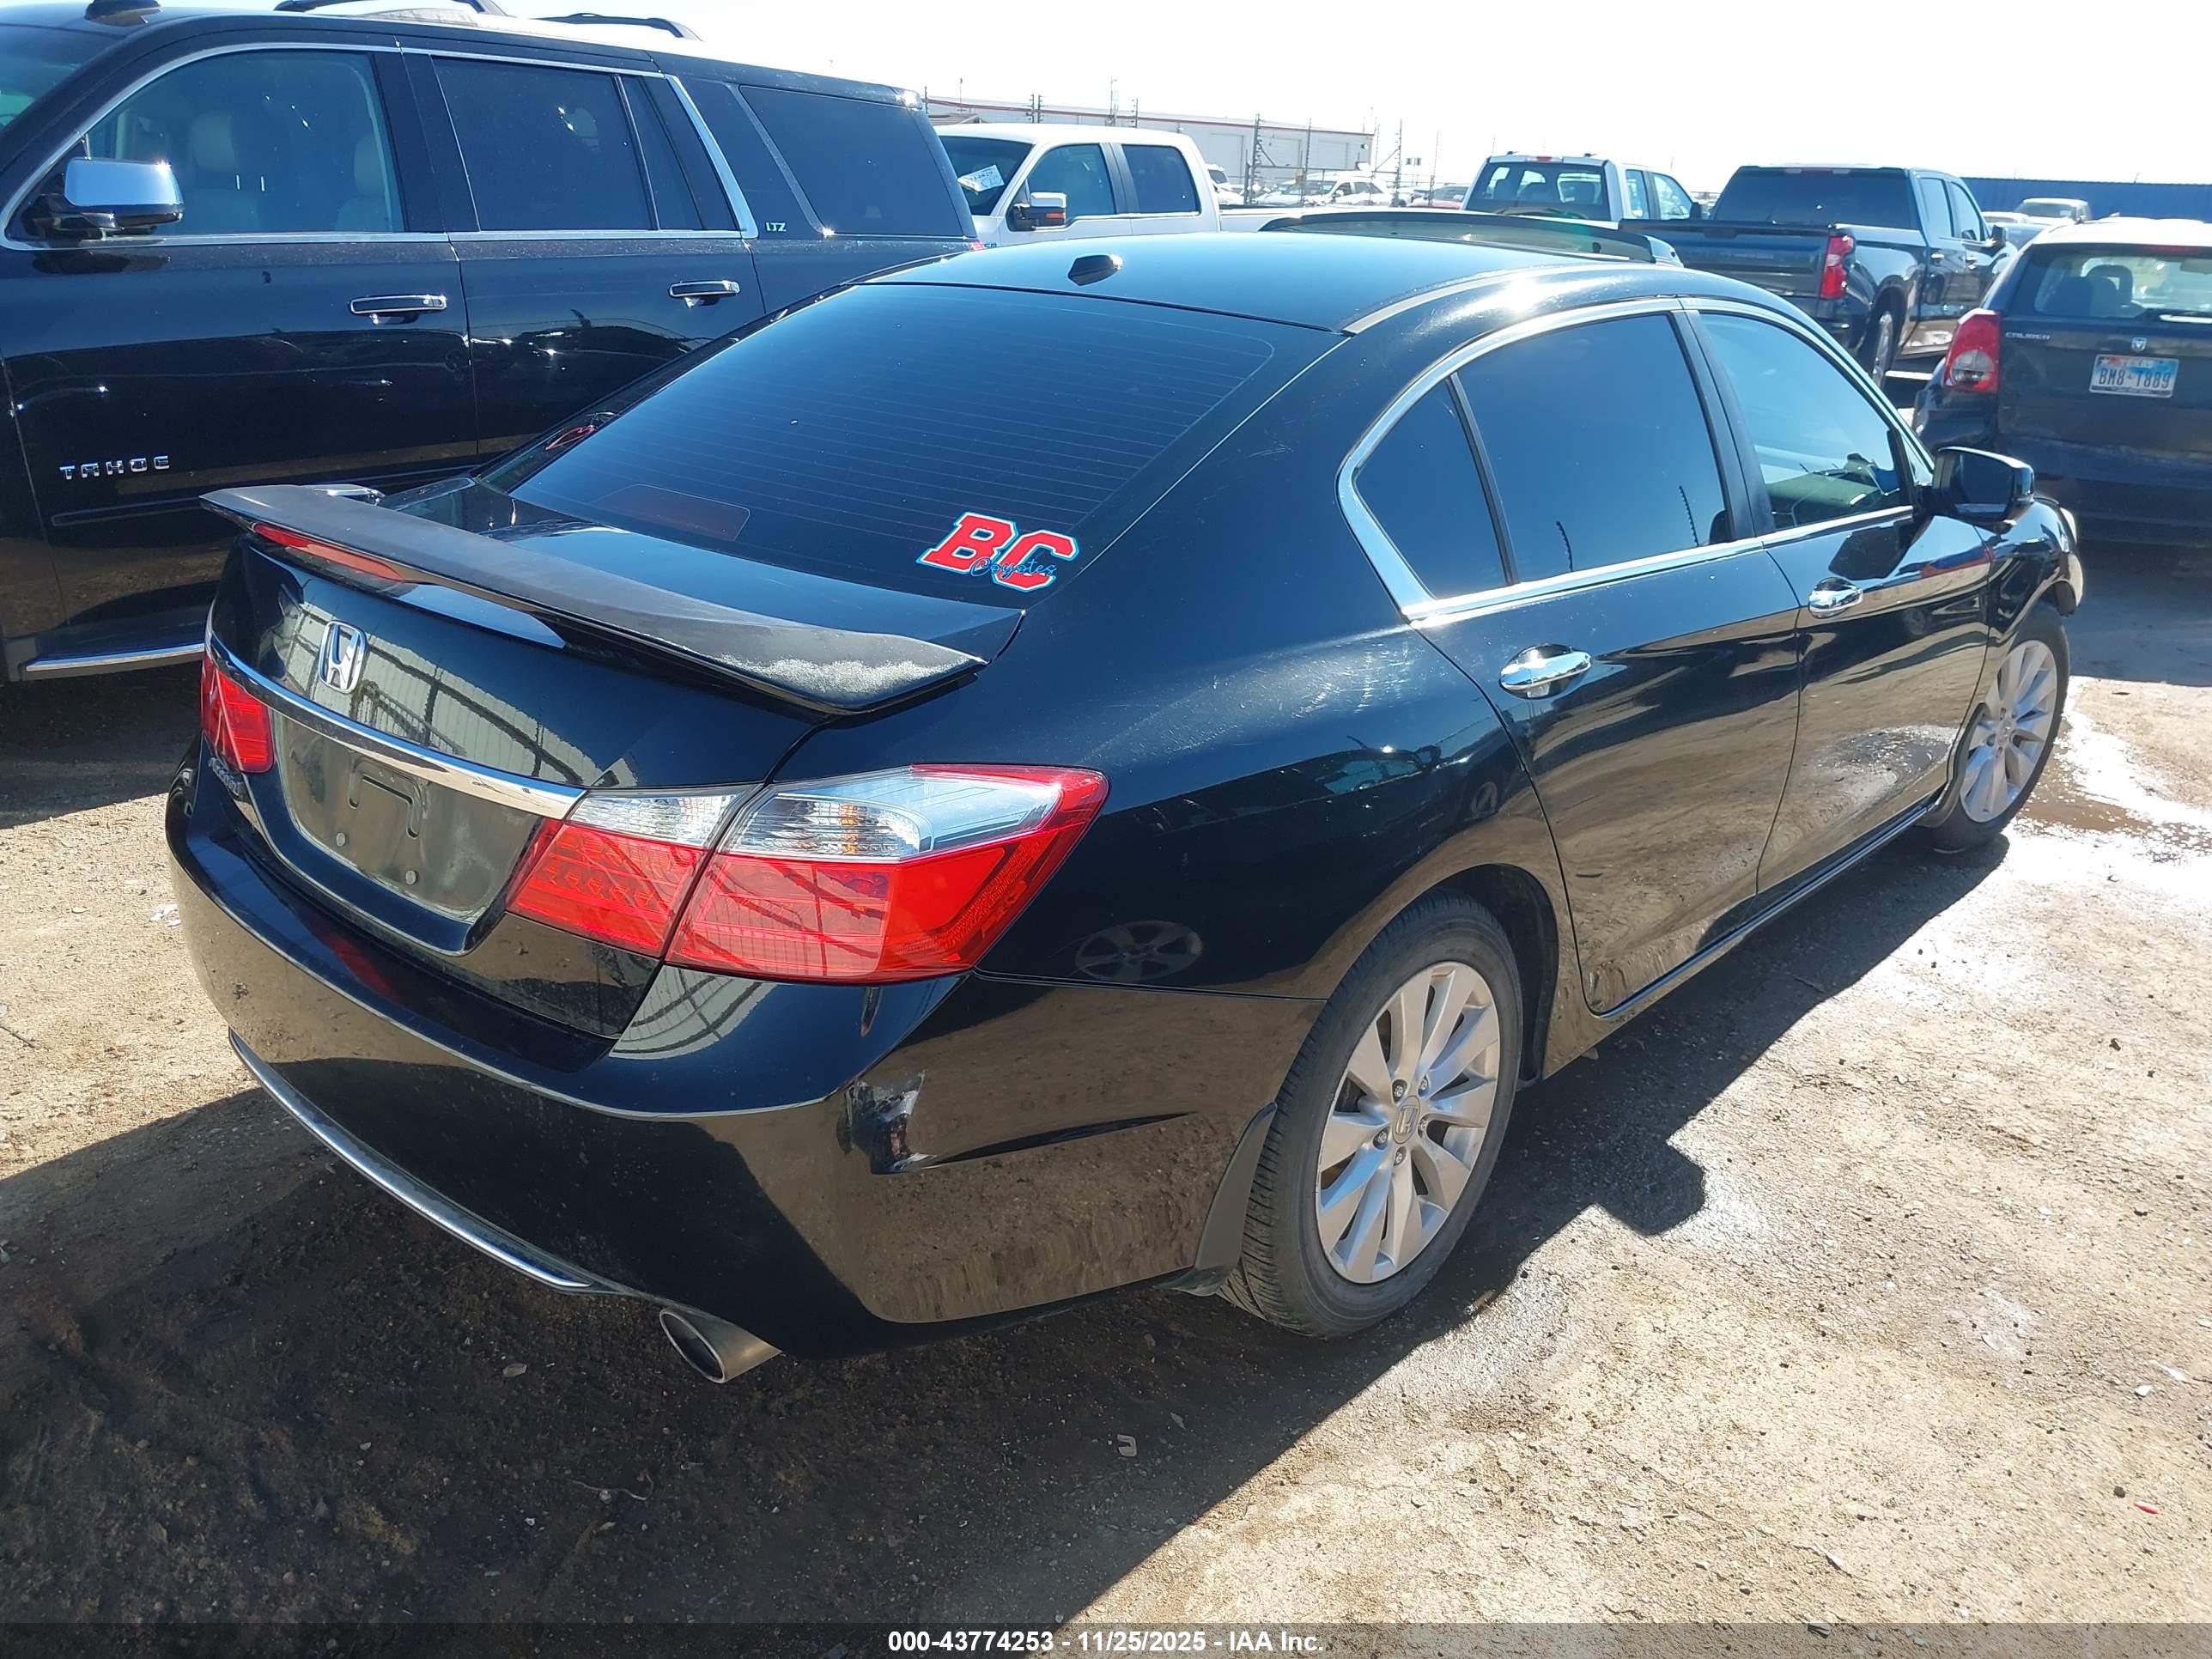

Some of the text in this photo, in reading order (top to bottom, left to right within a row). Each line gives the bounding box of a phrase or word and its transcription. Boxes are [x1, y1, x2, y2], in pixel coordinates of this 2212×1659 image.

[765, 222, 787, 232] LTZ
[59, 455, 170, 480] TAHOE
[915, 512, 1079, 592] BC
[969, 556, 1058, 580] Coyotes
